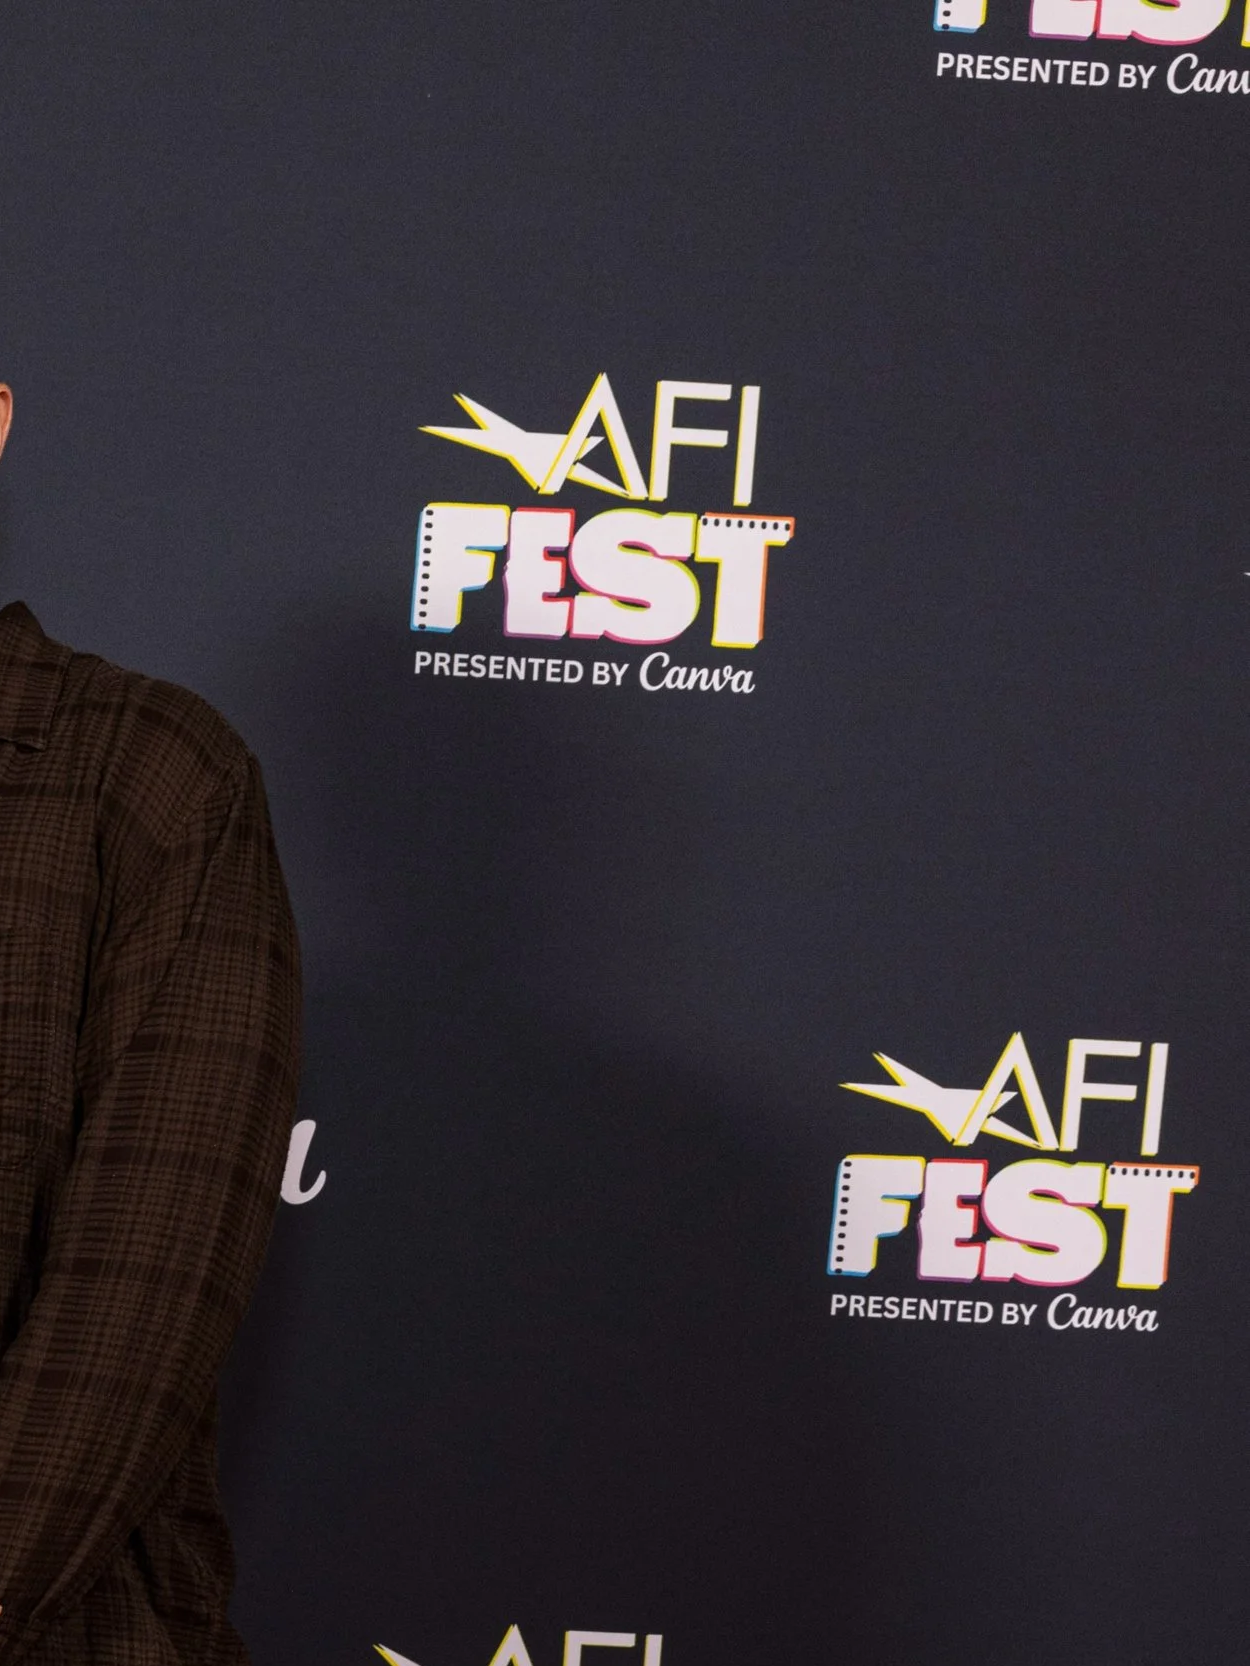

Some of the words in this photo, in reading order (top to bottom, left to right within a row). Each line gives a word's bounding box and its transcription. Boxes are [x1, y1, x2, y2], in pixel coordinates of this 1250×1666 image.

[937, 52, 1110, 87] PRESENTED
[1118, 64, 1157, 89] BY
[538, 371, 761, 506] AFI
[410, 502, 796, 649] FEST
[415, 651, 584, 684] PRESENTED
[592, 661, 630, 686] BY
[639, 651, 756, 694] Canva
[953, 1031, 1169, 1156] AFI
[827, 1153, 1200, 1290] FEST
[830, 1294, 994, 1324] PRESENTED
[1001, 1302, 1038, 1326] BY
[1046, 1293, 1159, 1332] Canva
